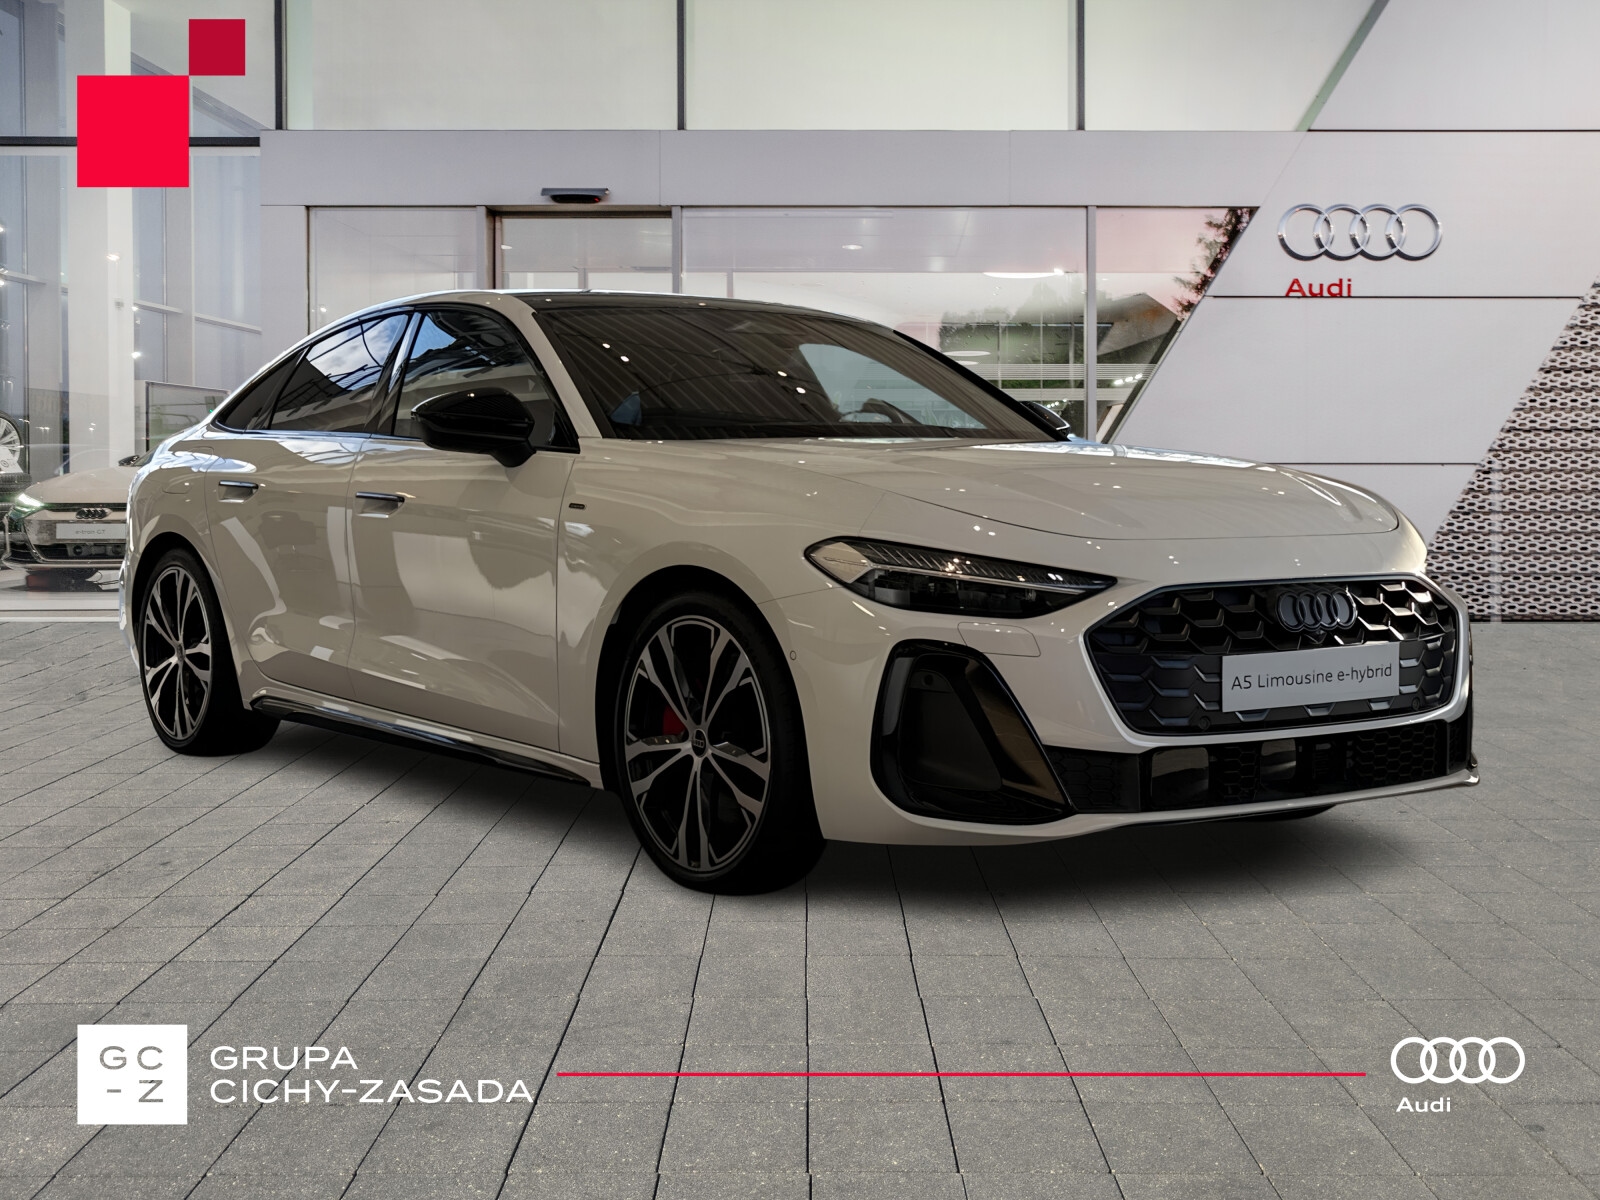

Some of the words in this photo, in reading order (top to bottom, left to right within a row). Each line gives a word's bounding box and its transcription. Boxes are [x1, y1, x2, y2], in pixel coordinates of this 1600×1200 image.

[1285, 278, 1352, 297] Audi
[1231, 675, 1252, 690] A5
[1257, 669, 1333, 688] Limousine
[1337, 664, 1392, 683] e-hybrid
